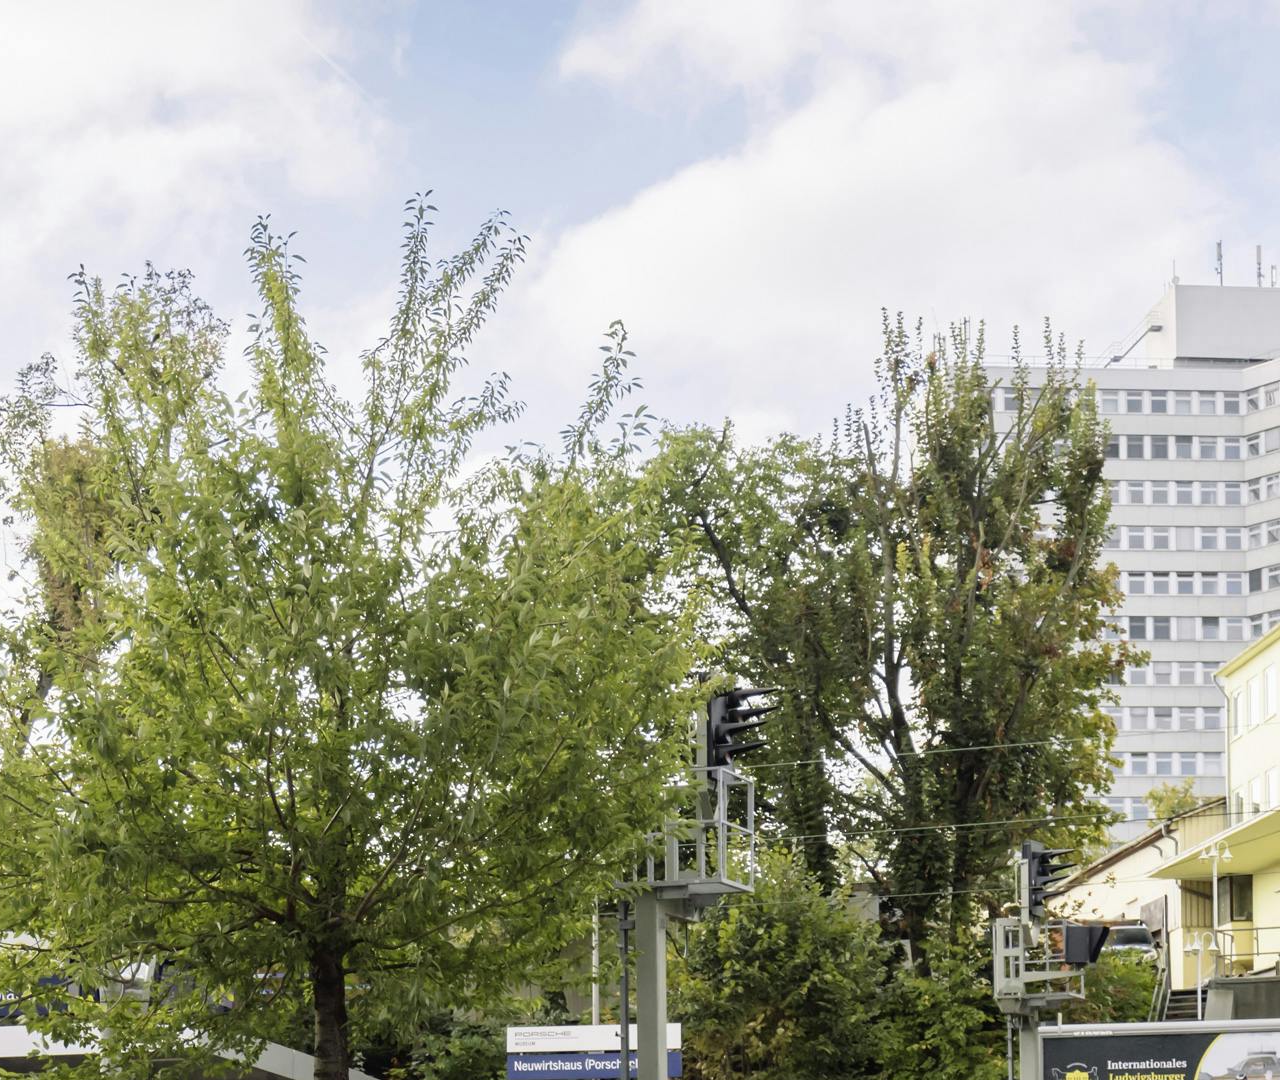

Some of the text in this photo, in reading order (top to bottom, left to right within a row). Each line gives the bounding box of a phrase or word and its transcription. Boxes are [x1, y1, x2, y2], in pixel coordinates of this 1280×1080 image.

[514, 1058, 638, 1072] Neuwirtshaus (Porschpl
[1107, 1059, 1187, 1070] Internationales
